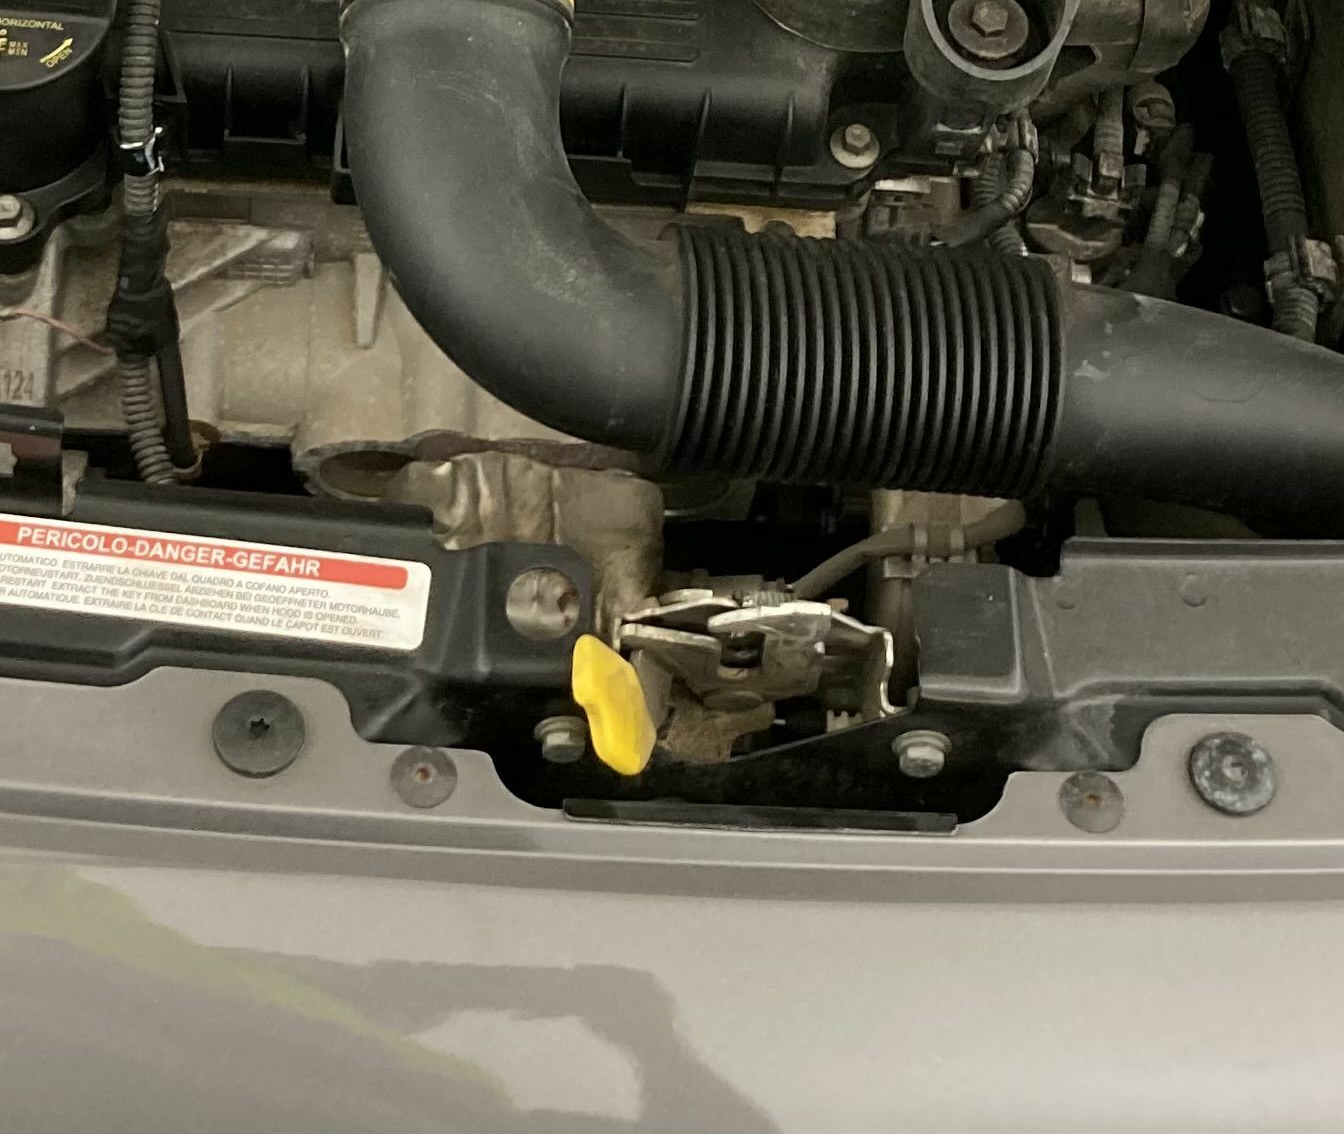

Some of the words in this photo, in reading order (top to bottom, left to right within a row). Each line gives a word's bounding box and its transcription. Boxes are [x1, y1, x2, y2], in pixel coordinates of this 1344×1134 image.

[45, 47, 73, 69] OPEN
[17, 526, 321, 577] PERICOLO-DANGER-GEFAHR
[62, 560, 115, 574] ESTRARRE
[117, 566, 131, 576] LA
[132, 568, 168, 580] CHIAVE
[170, 572, 189, 582] DAL
[191, 575, 234, 588] QUADRO
[236, 580, 243, 589] A
[245, 581, 286, 594] COFANO
[288, 586, 330, 599] APERTO.
[185, 585, 233, 599] ABZIEHEN
[236, 591, 252, 601] BEI
[254, 593, 327, 610] GEOEFFNETER
[51, 581, 97, 594] EXTRACT
[100, 587, 120, 597] THE
[122, 589, 141, 599] KEY
[144, 592, 173, 603] FROM
[175, 596, 237, 611] DASHBOARD
[240, 603, 270, 614] WHEN
[272, 607, 301, 618] HOOD
[303, 610, 313, 619] IS
[84, 596, 133, 610] EXTRAIRE
[135, 602, 147, 612] LA
[148, 604, 168, 614] CLE
[170, 606, 183, 616] DE
[185, 608, 232, 622] CONTACT
[234, 614, 269, 626] QUAND
[272, 618, 282, 628] LE
[285, 620, 318, 632] CAPOT
[321, 624, 339, 634] EST
